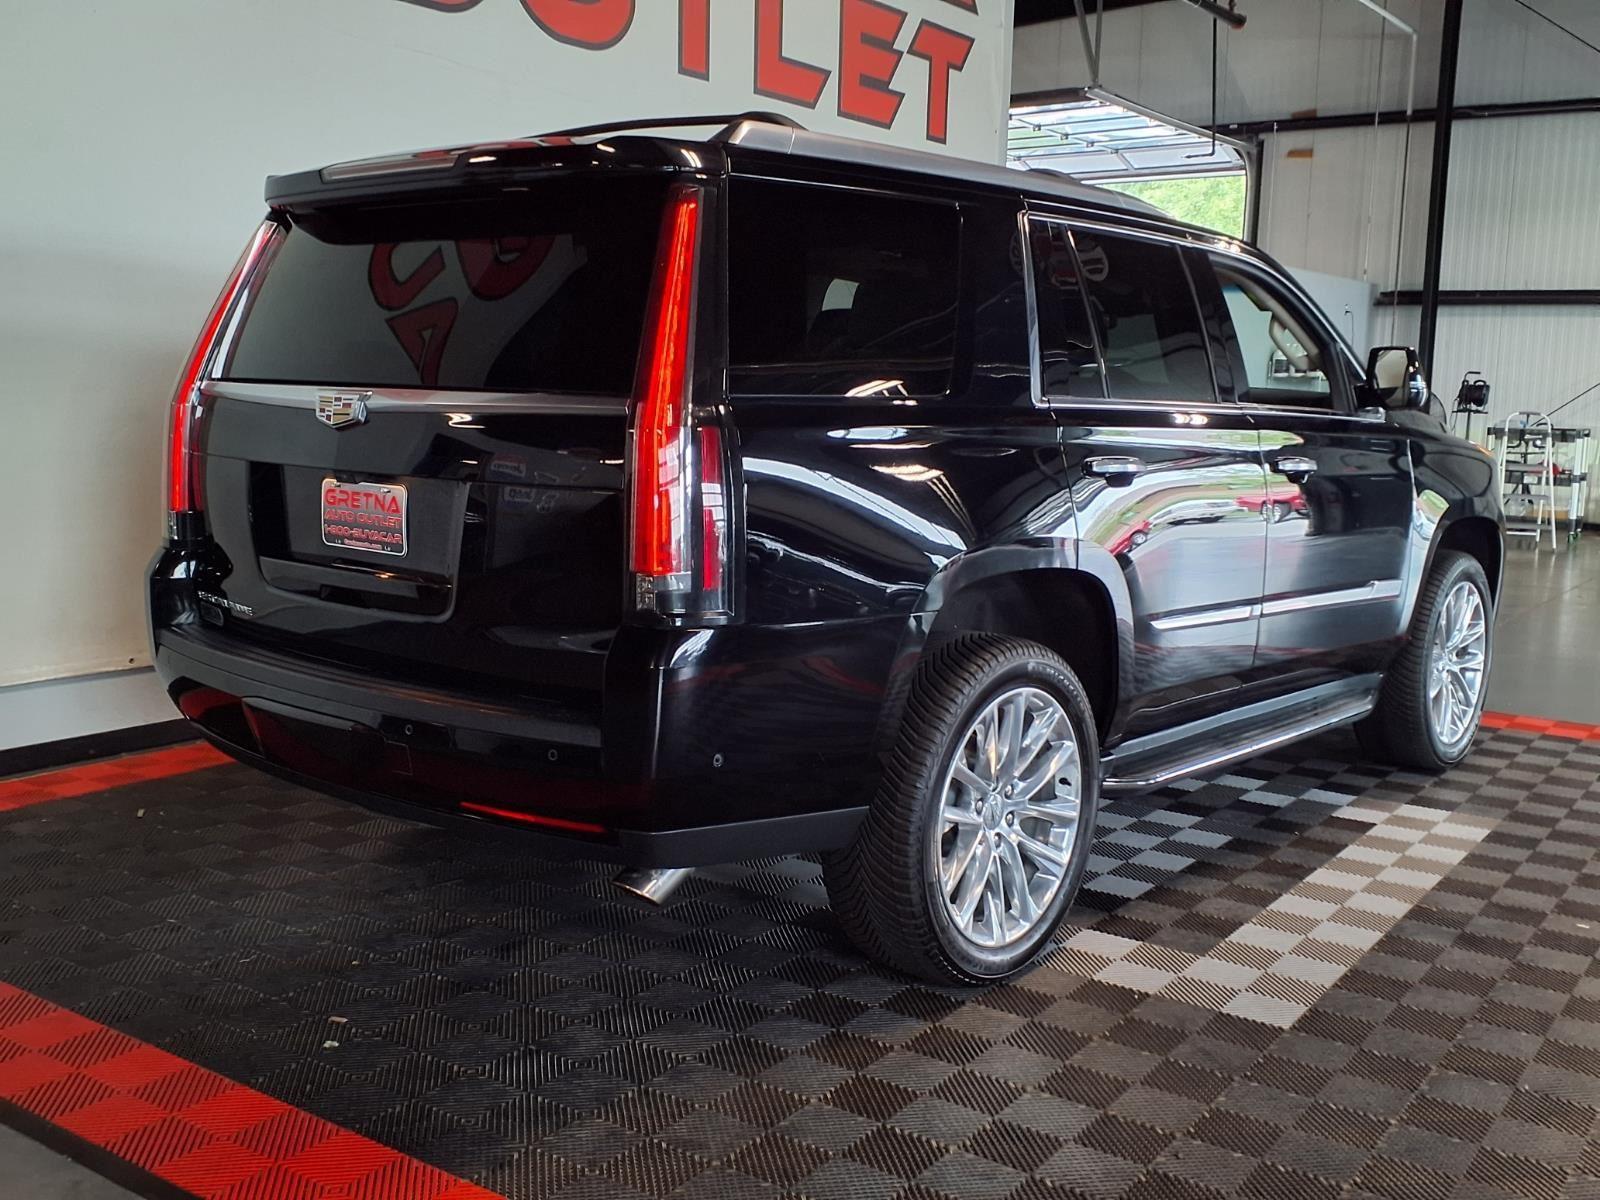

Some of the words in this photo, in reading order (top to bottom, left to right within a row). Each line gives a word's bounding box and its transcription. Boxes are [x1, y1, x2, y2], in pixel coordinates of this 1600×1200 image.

[325, 488, 401, 514] GRETNA
[323, 508, 355, 523] AUTO
[356, 513, 402, 528] OUTLET
